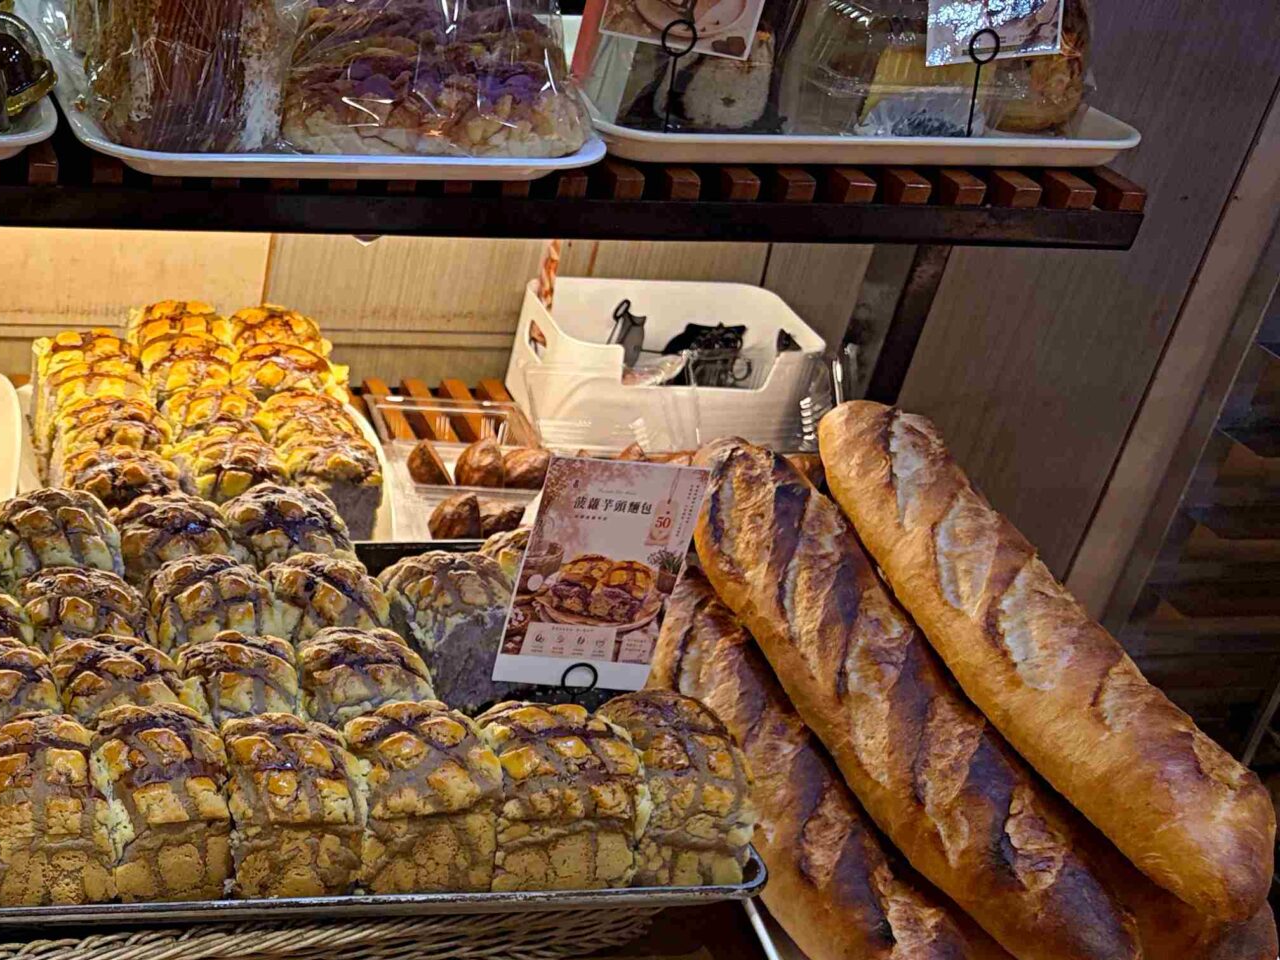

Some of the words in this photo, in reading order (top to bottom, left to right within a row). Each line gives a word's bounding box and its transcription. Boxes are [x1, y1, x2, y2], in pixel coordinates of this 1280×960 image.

[573, 495, 652, 515] 菠蘿芋頭麵包
[655, 516, 671, 529] 50
